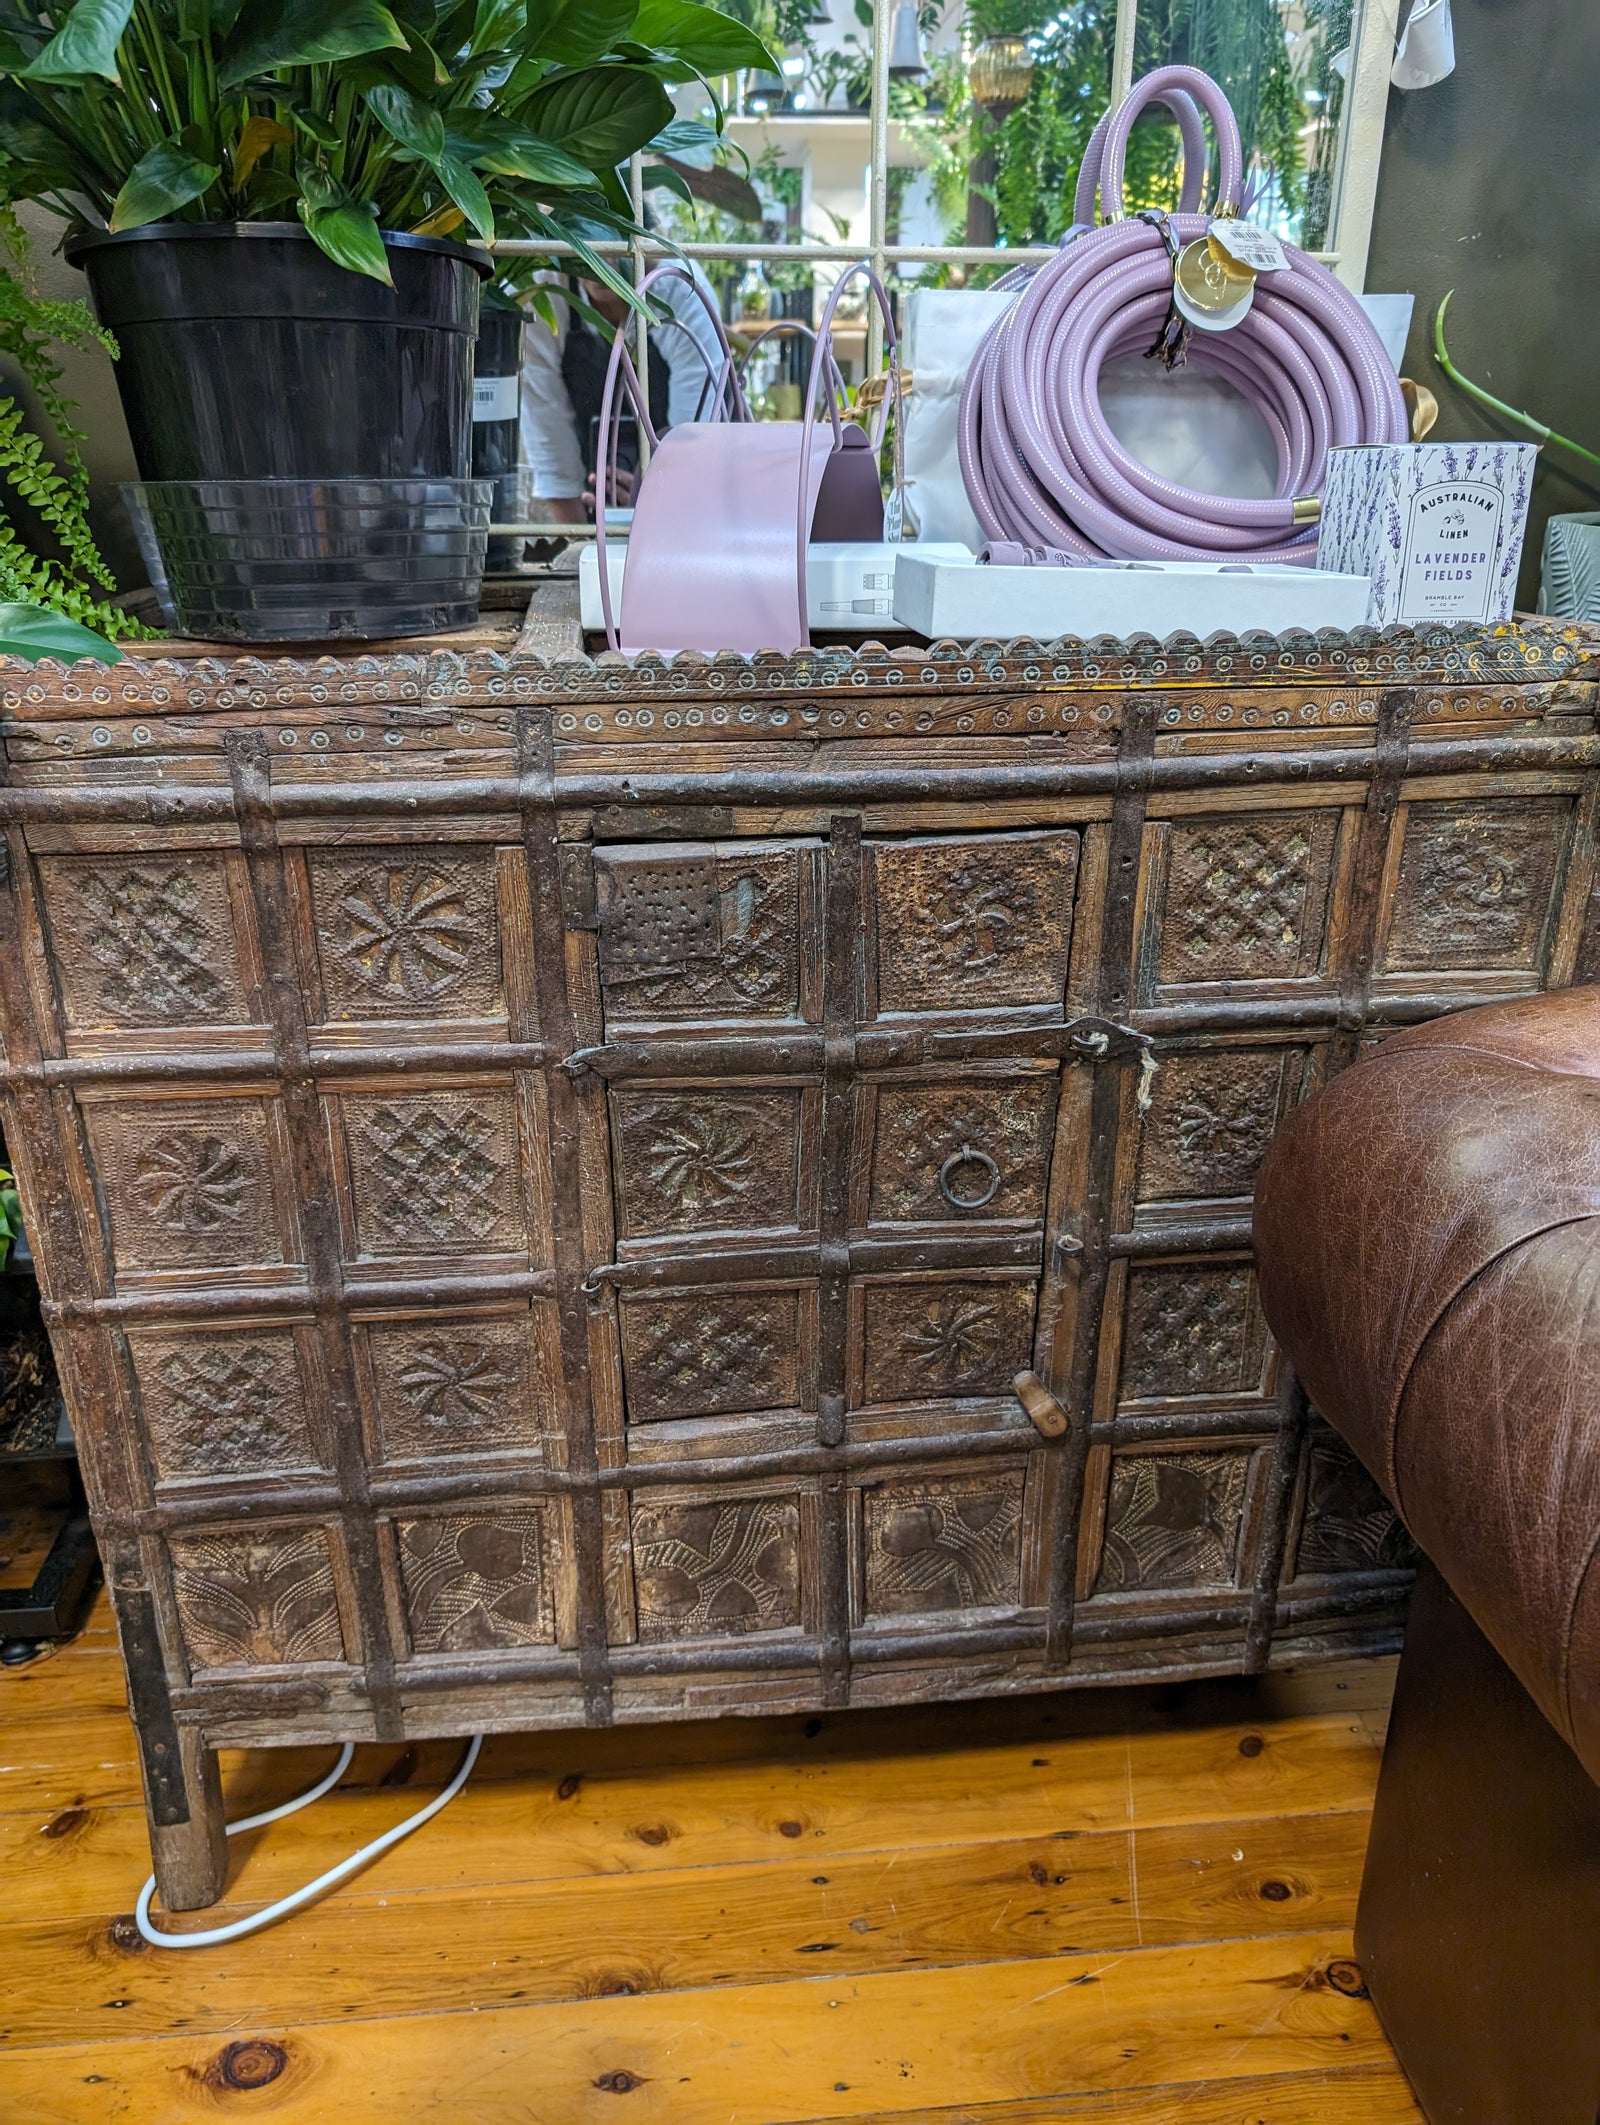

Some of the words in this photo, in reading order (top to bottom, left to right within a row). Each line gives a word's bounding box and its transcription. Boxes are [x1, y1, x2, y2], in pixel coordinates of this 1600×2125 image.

[1420, 493, 1494, 513] AUSTRALIAN
[1440, 529, 1469, 539] LINEN
[1415, 553, 1486, 564] LAVENDER
[1425, 570, 1472, 581] FIELDS
